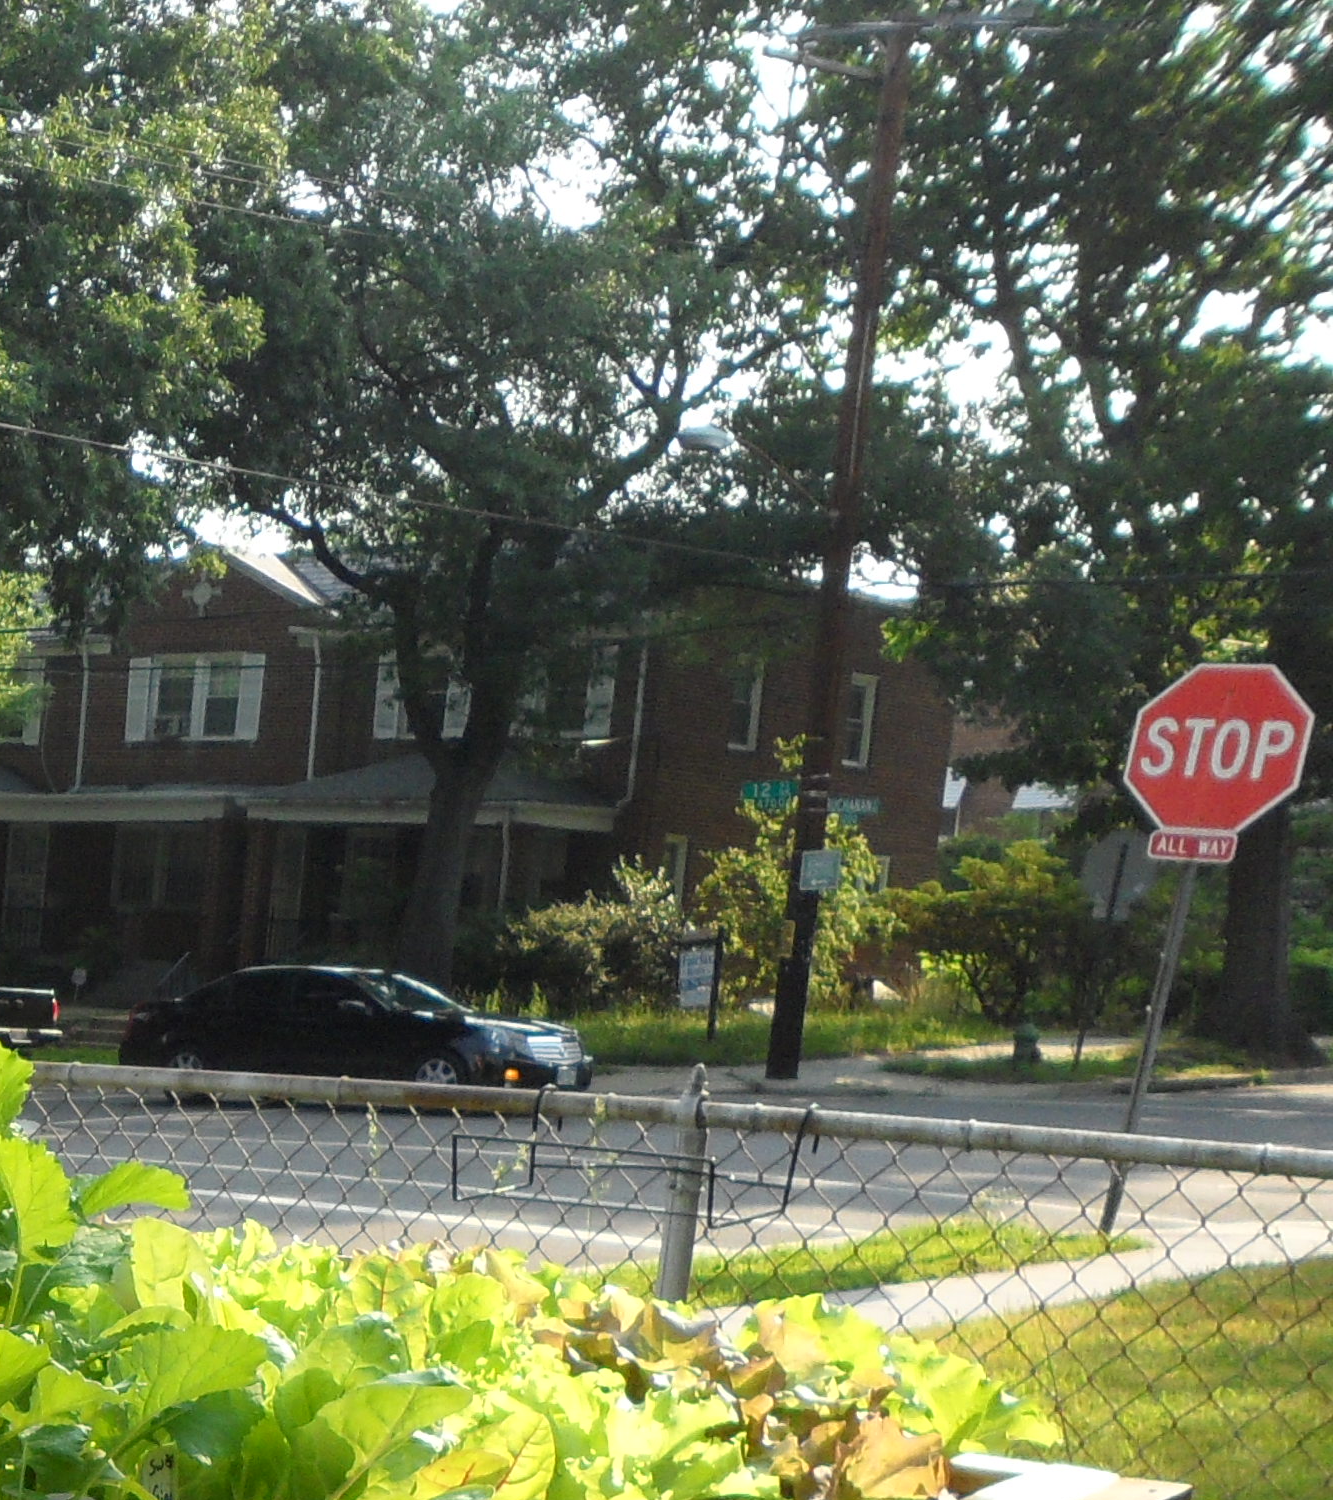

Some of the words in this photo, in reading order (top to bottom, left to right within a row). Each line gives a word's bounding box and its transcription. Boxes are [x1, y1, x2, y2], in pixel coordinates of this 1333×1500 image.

[1141, 717, 1294, 780] STOP
[753, 782, 772, 798] 12
[1156, 834, 1187, 854] ALL
[1198, 839, 1230, 856] WAY
